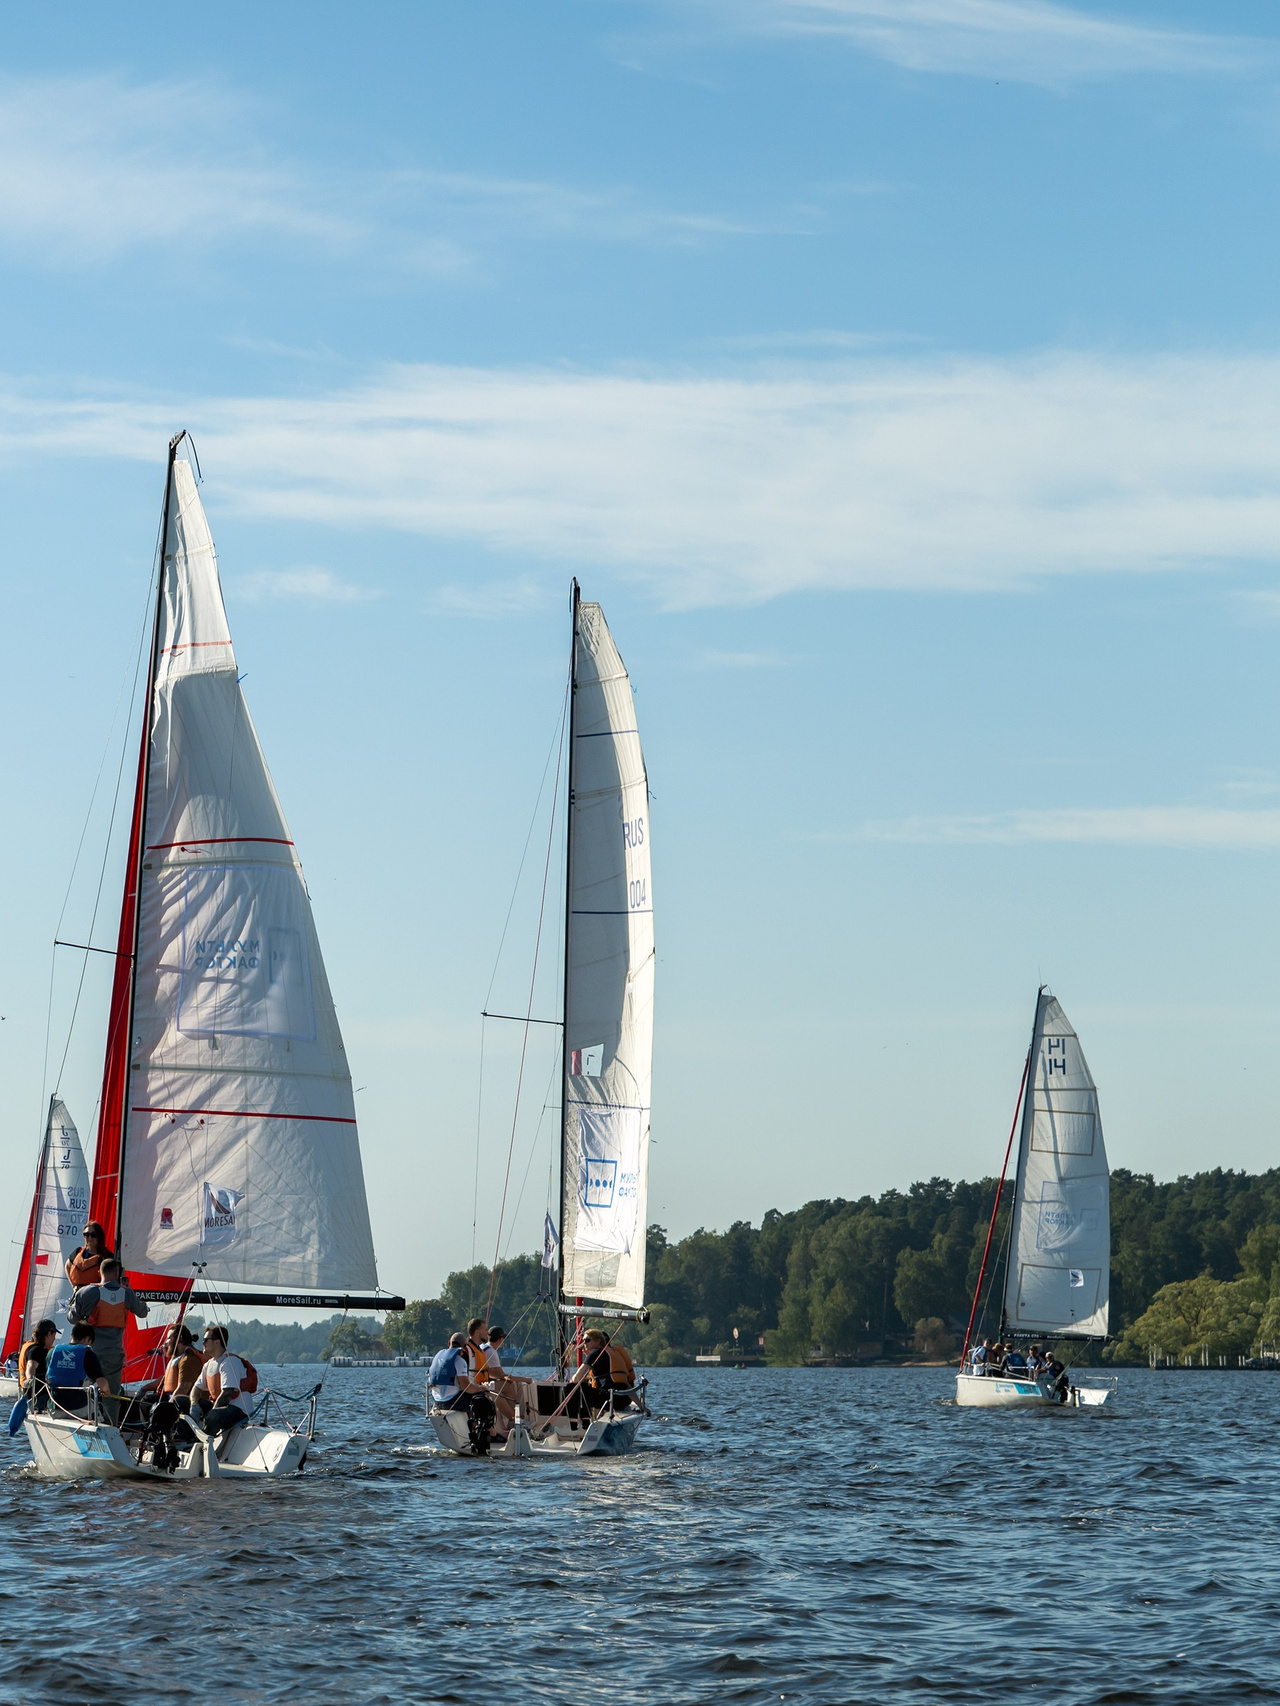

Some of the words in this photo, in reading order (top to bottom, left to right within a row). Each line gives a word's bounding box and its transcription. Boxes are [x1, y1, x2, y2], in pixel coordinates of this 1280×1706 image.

[622, 817, 644, 850] RUS
[629, 878, 646, 909] 004
[1048, 1058, 1066, 1075] 14
[63, 1150, 71, 1160] J
[70, 1198, 87, 1210] RUS
[57, 1224, 78, 1236] 670
[276, 1296, 322, 1305] MoreSail.ru
